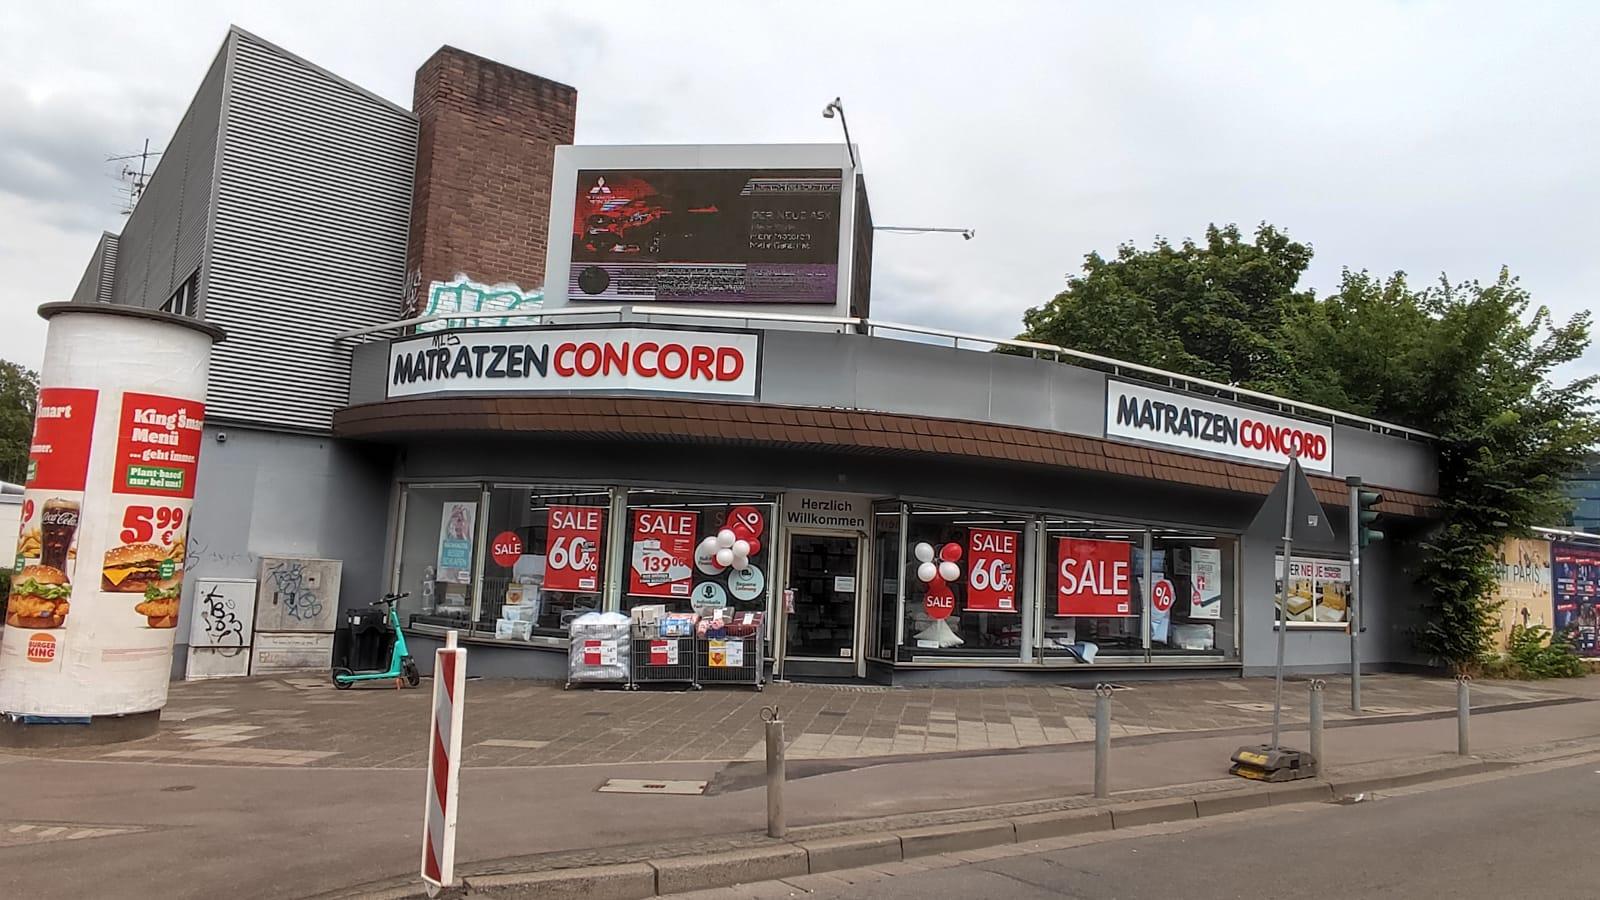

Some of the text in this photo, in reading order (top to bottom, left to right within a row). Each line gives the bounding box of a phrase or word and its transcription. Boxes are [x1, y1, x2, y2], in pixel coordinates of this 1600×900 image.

[393, 341, 745, 386] MATRATZEN CONCORD
[133, 408, 178, 431] King
[1116, 394, 1327, 462] MATRATZEN CONCORD
[131, 427, 179, 446] Menü
[142, 449, 169, 462] geht
[129, 478, 150, 486] nur
[801, 497, 852, 512] Herzlich
[551, 510, 599, 531] SALE
[638, 513, 692, 536] SALE
[787, 511, 865, 527] Willkommen
[494, 543, 521, 555] SALE
[972, 533, 1014, 553] SALE
[1060, 557, 1129, 596] SALE
[1290, 563, 1300, 577] ER
[1513, 563, 1540, 584] PARIS
[926, 595, 953, 608] SALE
[27, 647, 55, 658] KING
[28, 640, 56, 650] BURGER
